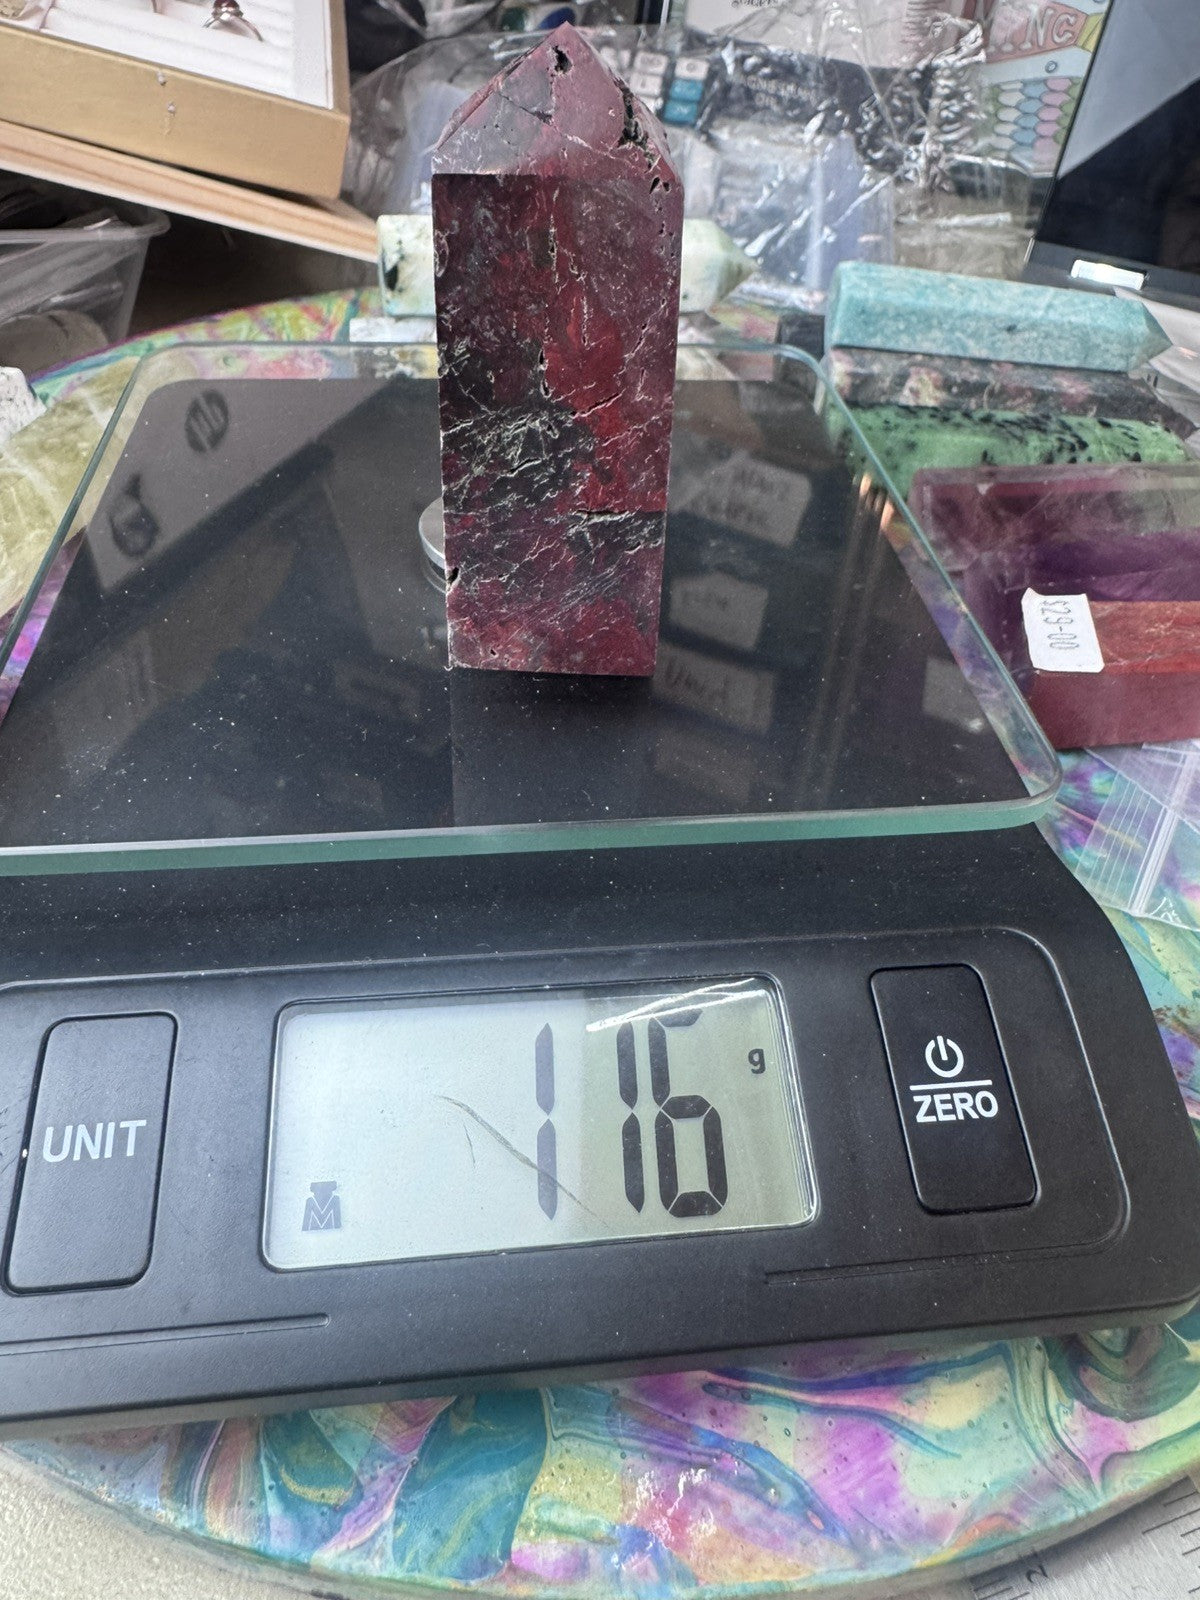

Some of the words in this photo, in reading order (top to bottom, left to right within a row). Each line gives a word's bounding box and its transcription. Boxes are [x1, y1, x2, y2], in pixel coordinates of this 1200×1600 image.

[535, 1008, 728, 1221] 116
[748, 1048, 767, 1075] g
[913, 1090, 999, 1123] ZERO
[43, 1119, 147, 1163] UNIT
